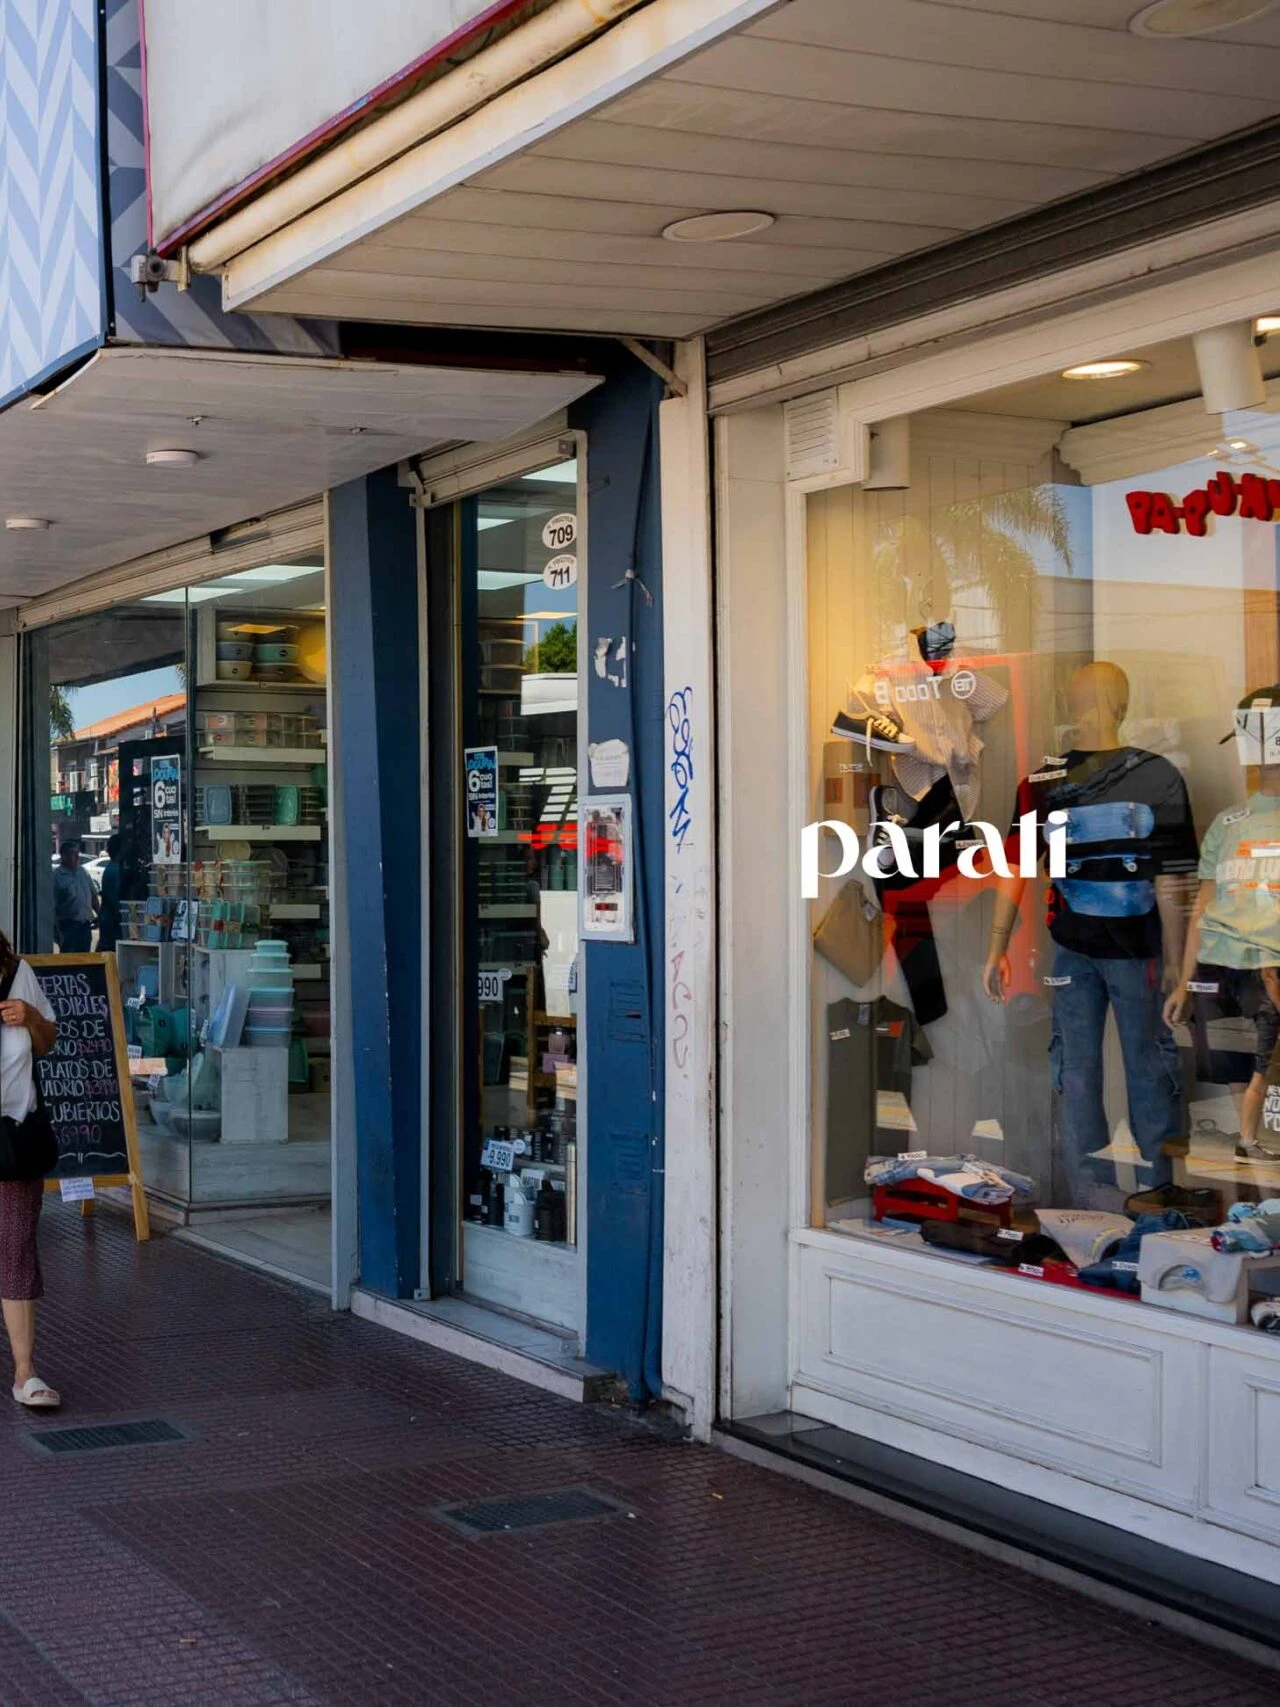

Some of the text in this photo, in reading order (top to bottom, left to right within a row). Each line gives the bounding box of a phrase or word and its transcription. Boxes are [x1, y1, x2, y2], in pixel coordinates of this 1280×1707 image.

[549, 525, 573, 546] 709
[550, 566, 570, 587] 711
[468, 769, 480, 793] 6
[154, 781, 166, 808] 6
[38, 973, 90, 996] ERTAS
[48, 995, 108, 1018] DIBLES
[83, 1020, 106, 1038] DE
[37, 1058, 113, 1079] PLATOS DE
[40, 1079, 85, 1097] VIDRIO
